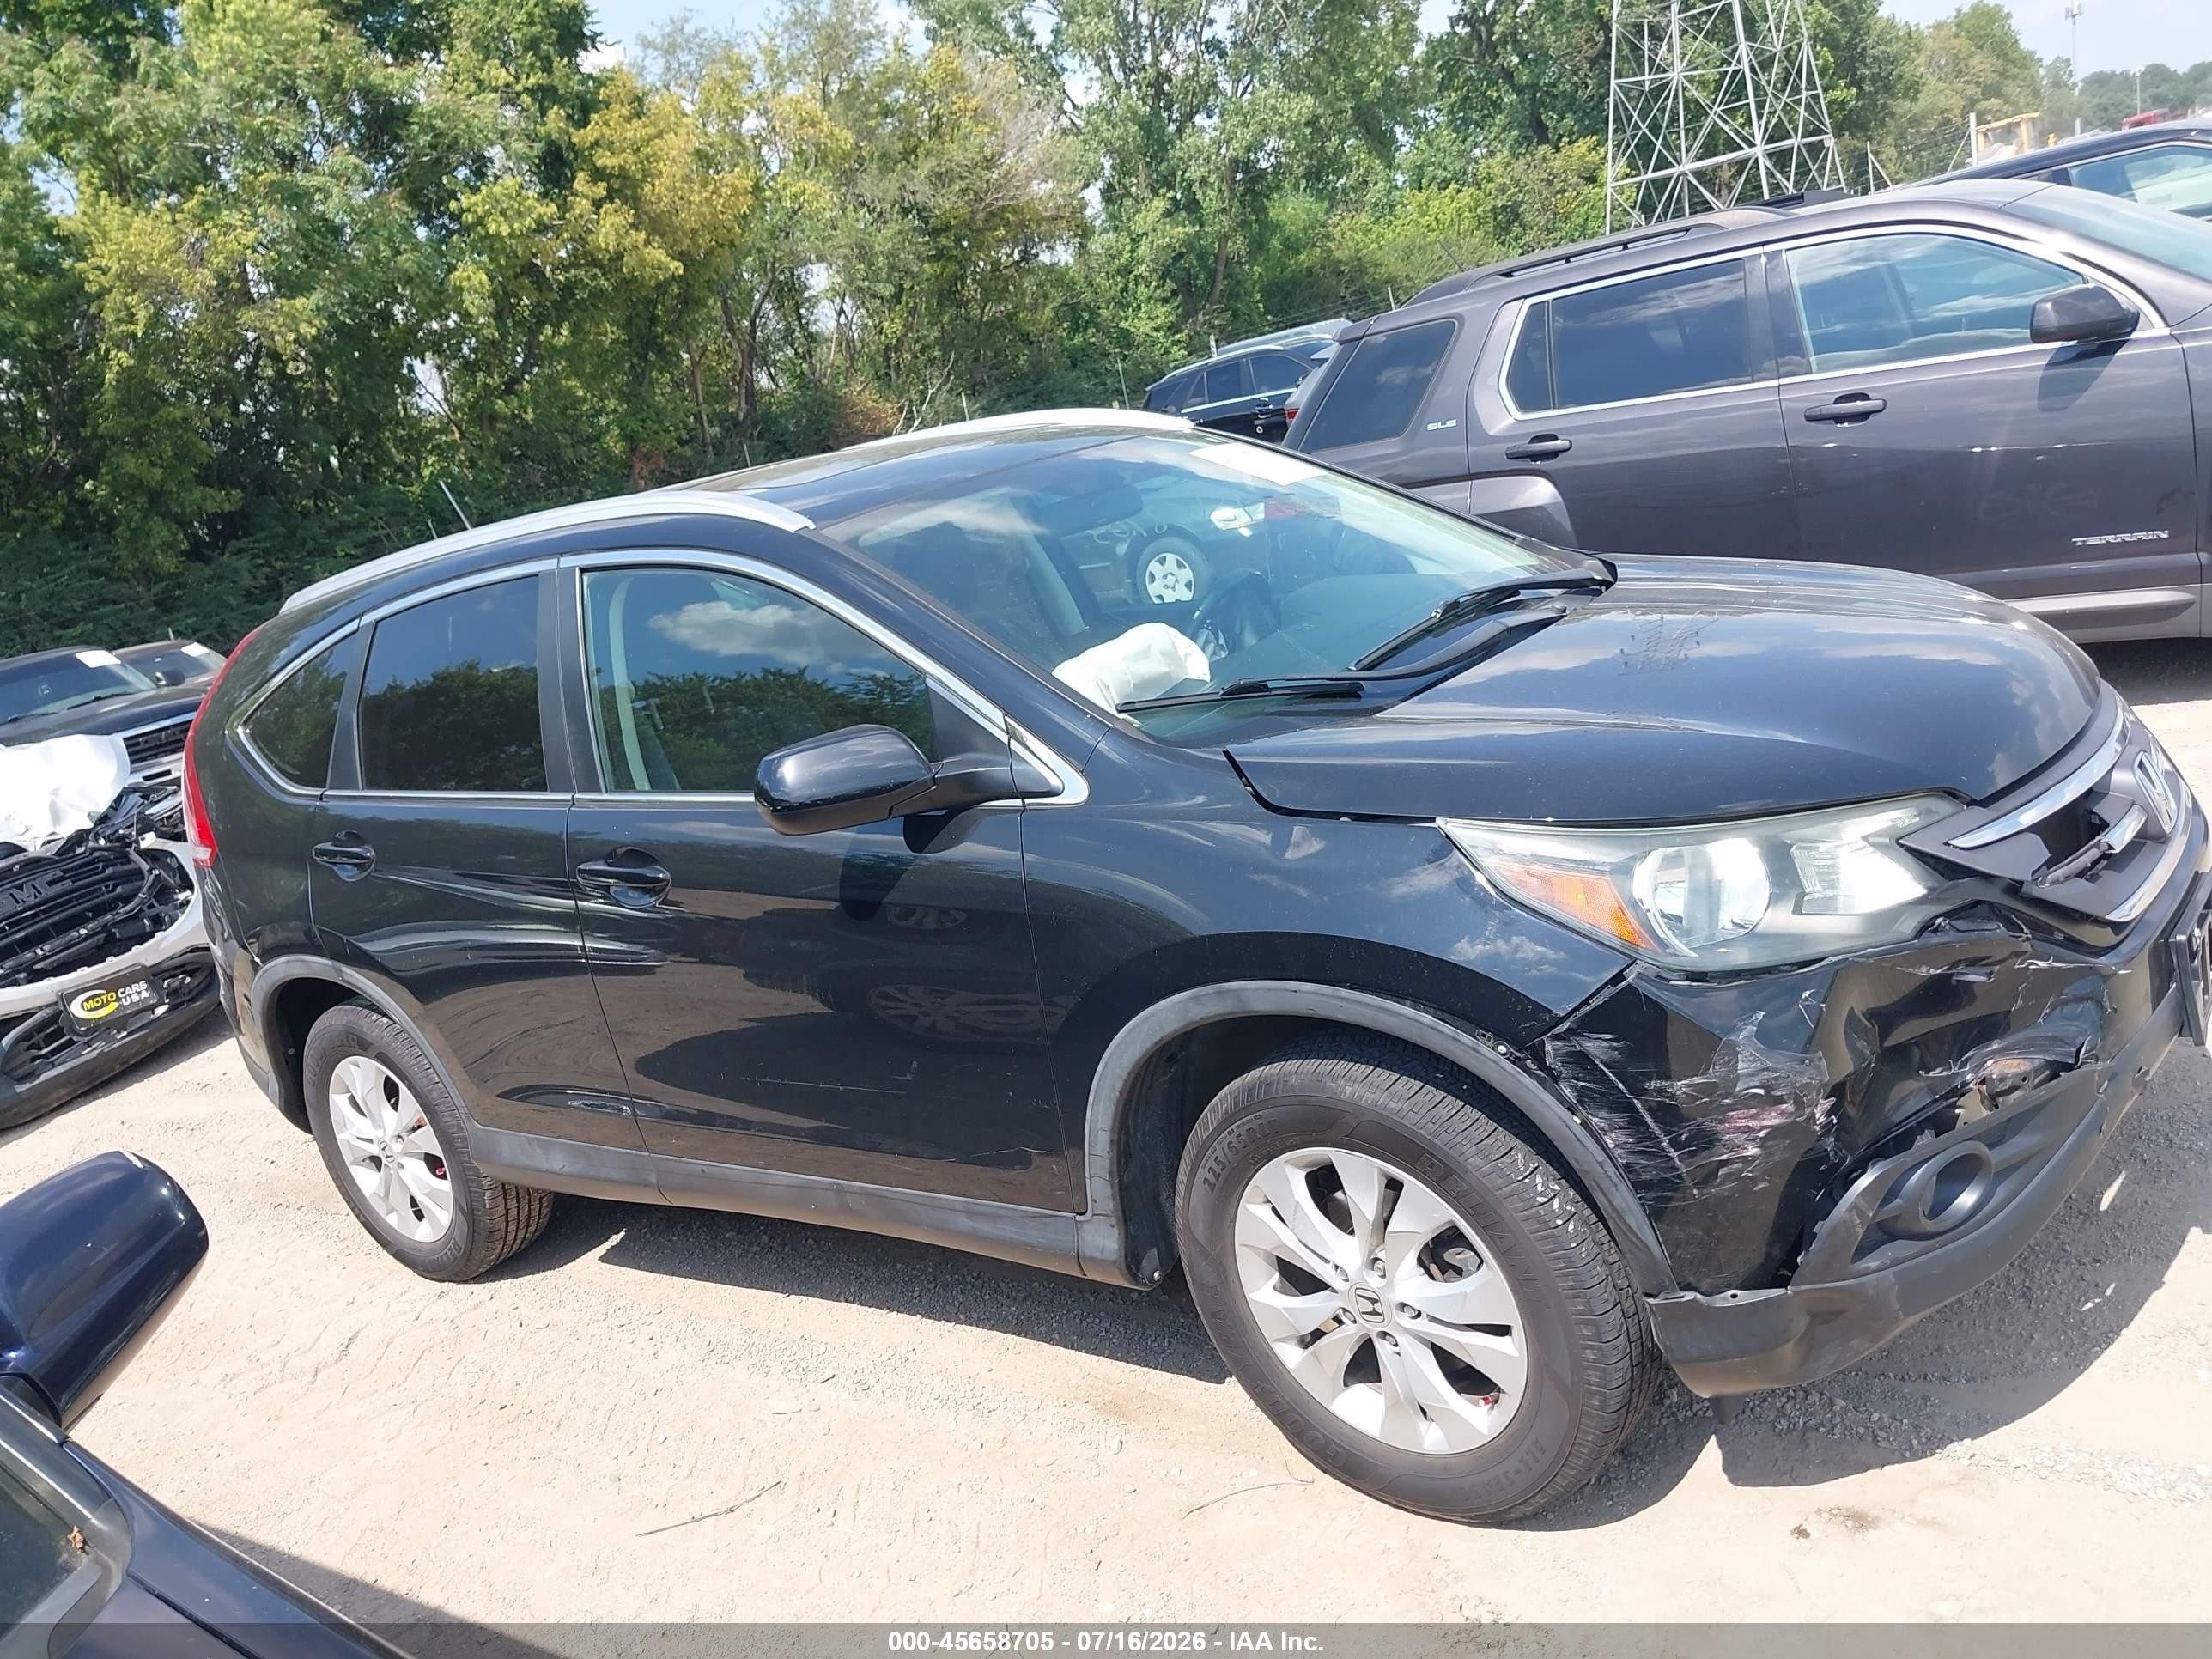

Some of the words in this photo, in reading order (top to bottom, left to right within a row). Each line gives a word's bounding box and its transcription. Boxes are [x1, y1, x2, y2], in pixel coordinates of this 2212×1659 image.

[1427, 419, 1457, 431] SLE
[2071, 530, 2169, 546] TERRAIN
[82, 992, 117, 1011] MOTO
[118, 980, 148, 998] CARS
[121, 990, 150, 1006] USA
